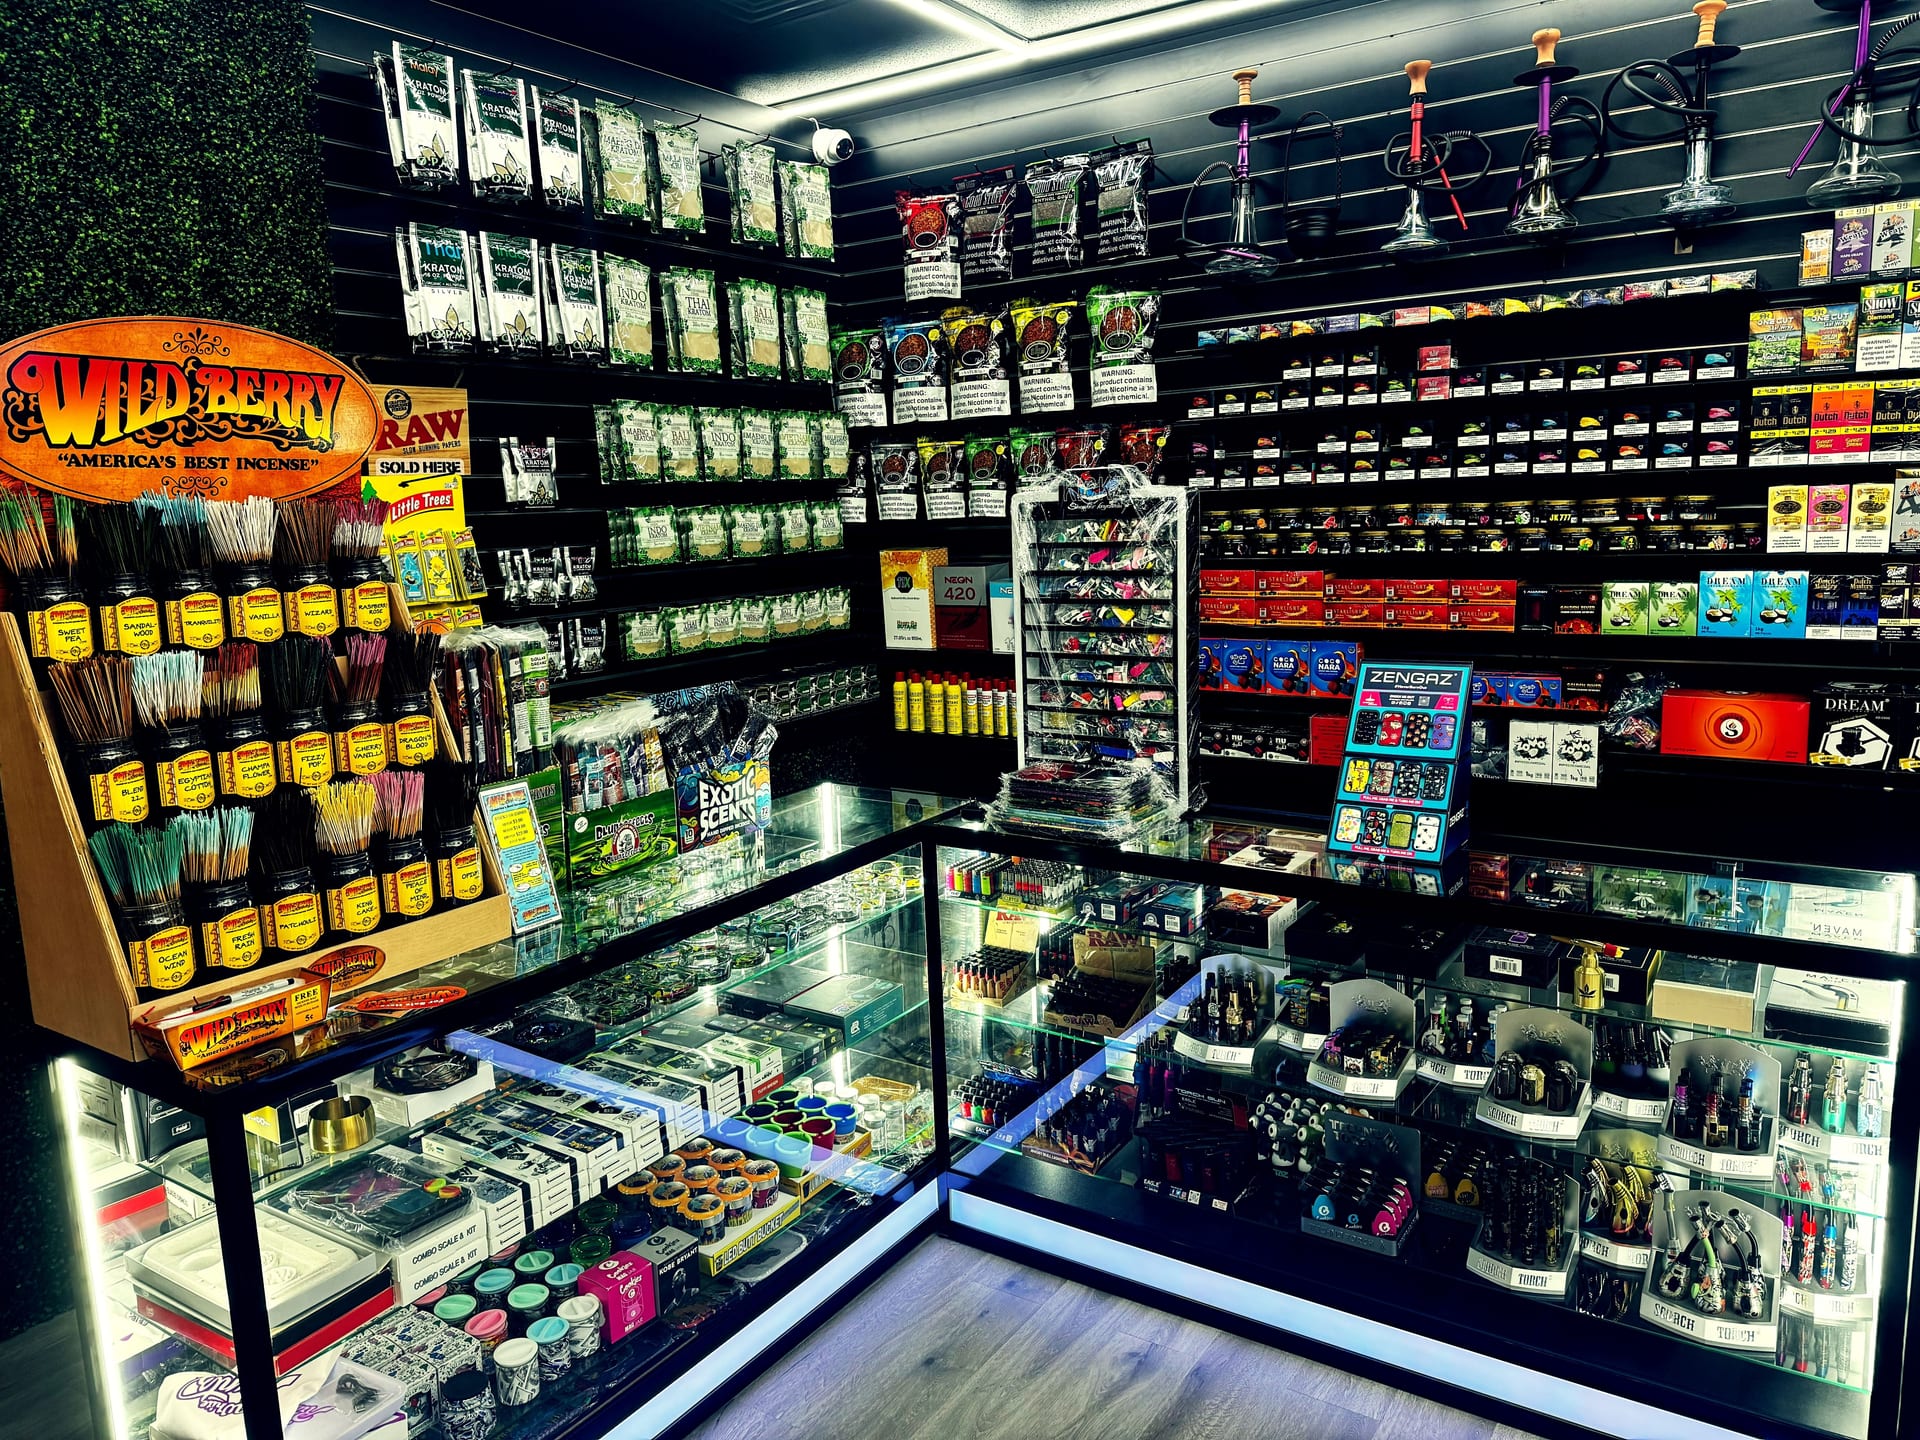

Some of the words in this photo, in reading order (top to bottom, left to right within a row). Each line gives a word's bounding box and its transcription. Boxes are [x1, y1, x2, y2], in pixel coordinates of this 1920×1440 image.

[408, 78, 447, 95] KRATOM
[481, 102, 521, 117] KRATOM
[544, 117, 575, 133] KRATOM
[1880, 225, 1908, 239] Wraps
[424, 239, 462, 259] Thai
[424, 263, 464, 275] KRATOM
[494, 263, 531, 276] KRATOM
[911, 265, 942, 273] WARNING:
[563, 274, 593, 286] KRATOM
[502, 294, 529, 302] SILVER
[617, 286, 647, 303] INDO
[620, 298, 646, 309] KRATOM
[685, 296, 710, 309] THAI
[1864, 296, 1900, 312] SHOW
[688, 307, 712, 317] KRATOM
[754, 307, 774, 319] BALI
[1832, 313, 1850, 321] CUT
[1867, 313, 1894, 321] Diamond
[754, 317, 774, 326] KRATOM
[1778, 317, 1794, 325] CUT
[1101, 369, 1135, 377] WARNING:
[1100, 378, 1123, 386] product
[10, 351, 191, 446] WILD
[197, 366, 345, 444] BERRY
[1783, 416, 1807, 425] Dutch
[1814, 413, 1838, 422] Dutch
[1844, 411, 1868, 420] Dutch
[1876, 411, 1901, 420] Dutch
[1754, 418, 1777, 426] Dutch
[376, 409, 466, 451] RAW
[625, 428, 650, 437] MAENG
[671, 430, 691, 442] BALI
[711, 432, 736, 442] INDO
[403, 446, 416, 455] SLOW
[442, 440, 461, 449] PAPERS
[184, 456, 229, 470] BEST
[380, 460, 421, 474] SOLD
[423, 461, 461, 473] HERE
[391, 498, 420, 521] Little
[422, 493, 452, 507] Trees
[944, 576, 973, 584] NEON
[1707, 576, 1746, 586] DREAM
[1761, 576, 1801, 586] DREAM
[944, 587, 976, 600] 420
[1461, 585, 1494, 593] STARLIGHT
[1610, 590, 1641, 598] DREAM
[1657, 590, 1689, 598] DREAM
[58, 627, 85, 636] SWEET
[123, 623, 157, 631] SANDAL-
[134, 629, 154, 637] WOOD
[1318, 663, 1340, 671] NARA
[1370, 671, 1452, 686] ZENGAZ
[1825, 698, 1884, 711] DREAM
[355, 743, 383, 751] CHERRY
[405, 741, 429, 750] BLOOD
[1516, 738, 1545, 751] ZOMO
[1561, 739, 1591, 753] ZOMO
[301, 753, 327, 762] FIZZY
[353, 750, 384, 760] VANILLA
[241, 762, 271, 773] CHAMPA
[308, 759, 321, 768] POP
[242, 770, 271, 780] FLOWER
[121, 786, 144, 797] BLEND
[700, 768, 756, 809] EXOTIC
[700, 803, 756, 839] SCENTS
[685, 828, 694, 838] 10
[406, 880, 427, 889] PEACE
[414, 887, 423, 895] OF
[356, 900, 373, 909] KING
[356, 907, 375, 916] CAKE
[279, 917, 317, 930] PATCHOULI
[231, 931, 255, 943] FRESH
[235, 939, 255, 949] RAIN
[158, 950, 188, 963] OCEAN
[345, 950, 377, 969] BERRY
[164, 960, 186, 970] WIND
[294, 988, 319, 1002] FREE
[180, 1018, 236, 1057] WILD
[236, 998, 288, 1027] BERRY
[235, 1037, 250, 1047] Best
[1488, 1106, 1517, 1126] SCORCH
[413, 1247, 437, 1264] COMBO
[438, 1234, 458, 1251] SCALE
[467, 1225, 476, 1235] KIT
[724, 1248, 737, 1264] LED
[737, 1233, 756, 1254] BUTT
[756, 1215, 784, 1242] BUCKET
[659, 1261, 676, 1275] KOBE
[677, 1247, 698, 1264] BRYANT
[414, 1272, 438, 1290] COMBO
[440, 1259, 460, 1276] SCALE
[468, 1249, 477, 1260] KIT
[620, 1275, 642, 1294] Cookies
[1518, 1274, 1547, 1287] TORCH
[1655, 1303, 1694, 1331] SCORCH
